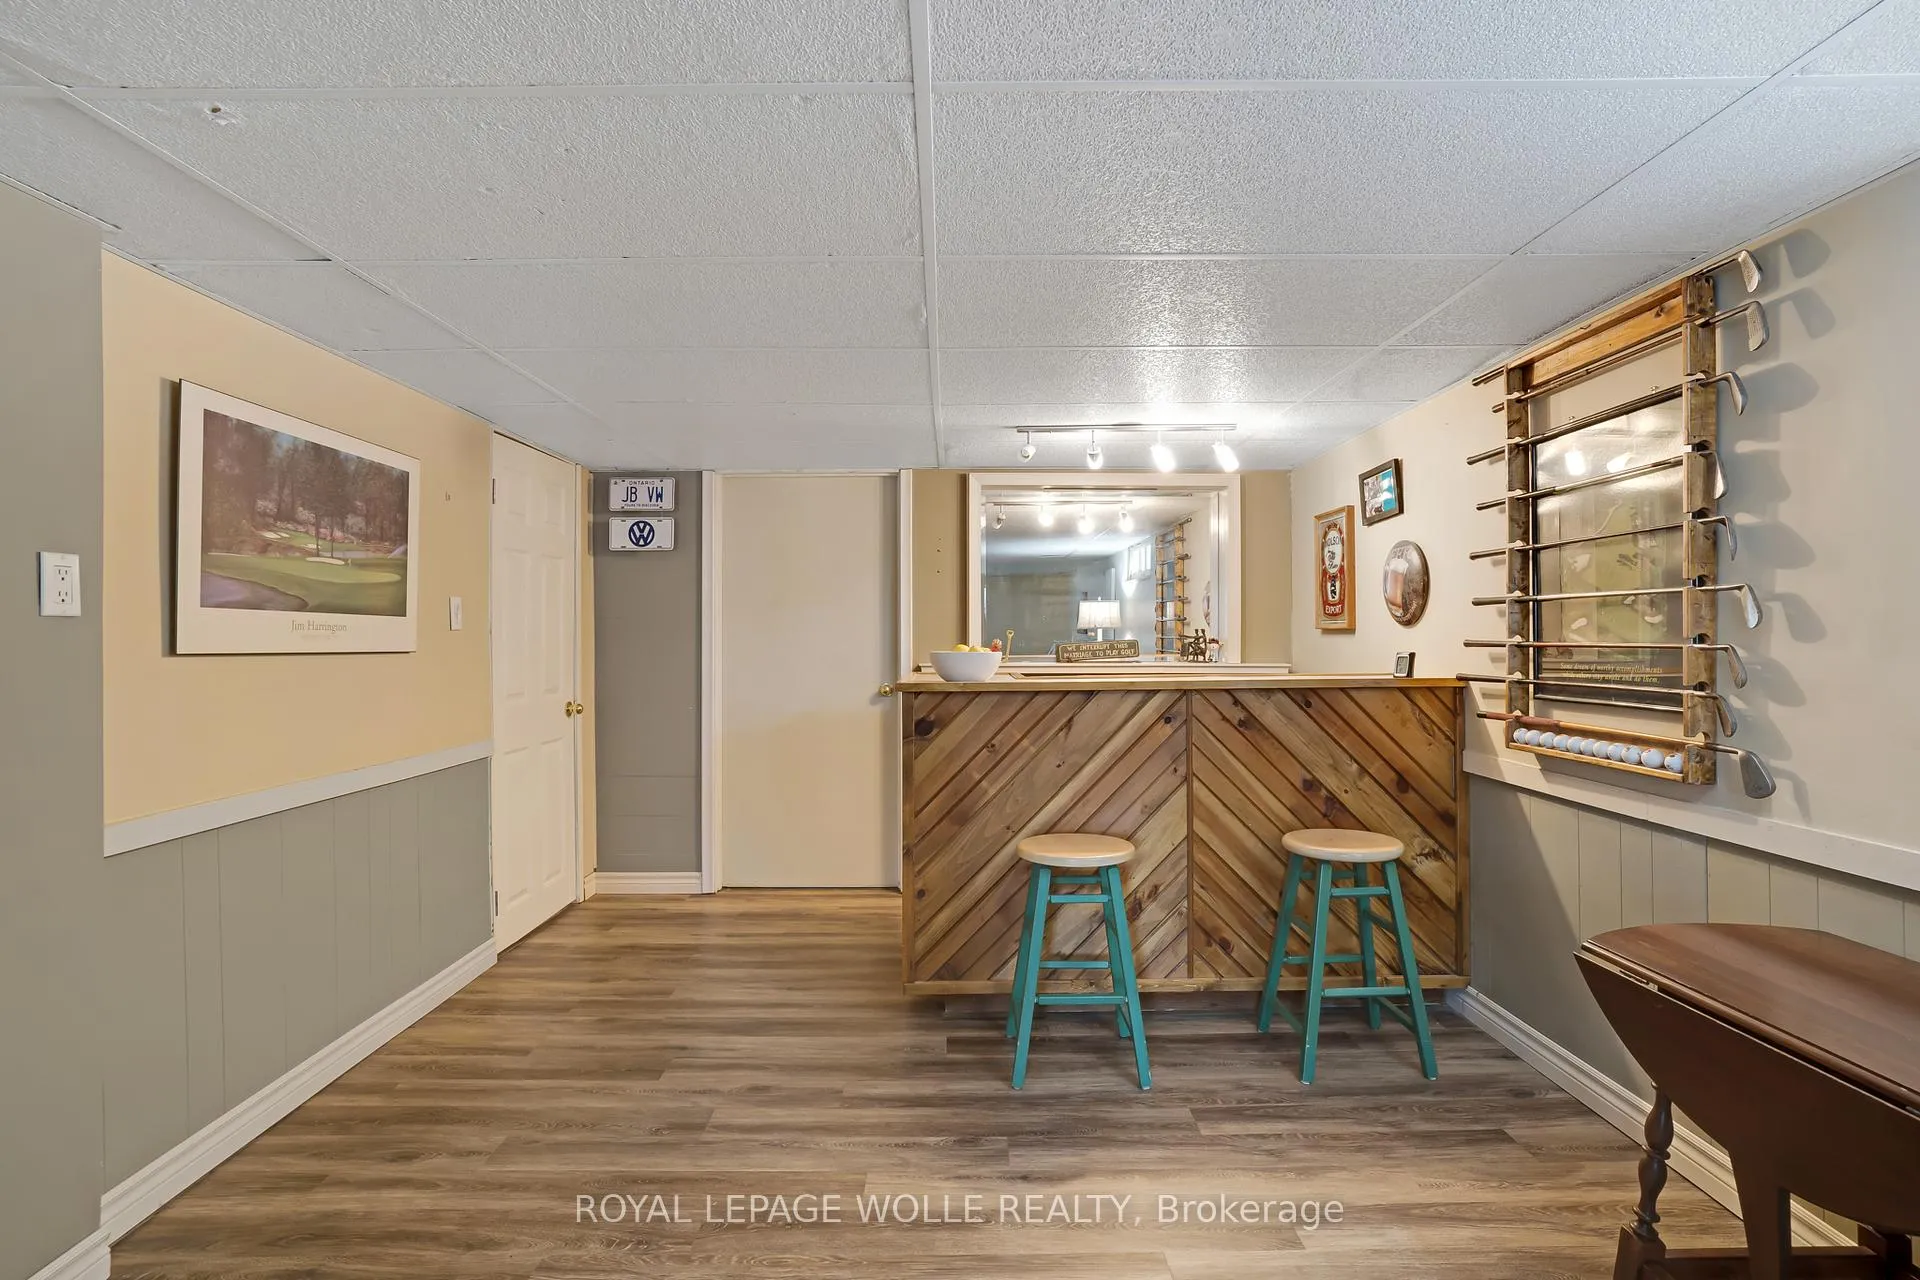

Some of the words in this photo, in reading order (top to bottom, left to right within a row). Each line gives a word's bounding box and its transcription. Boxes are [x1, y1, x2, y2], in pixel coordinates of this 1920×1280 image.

[621, 486, 638, 503] JB
[647, 486, 664, 503] VW
[1325, 604, 1342, 614] EXPORT
[291, 619, 305, 632] Jim
[307, 619, 348, 634] Harrington
